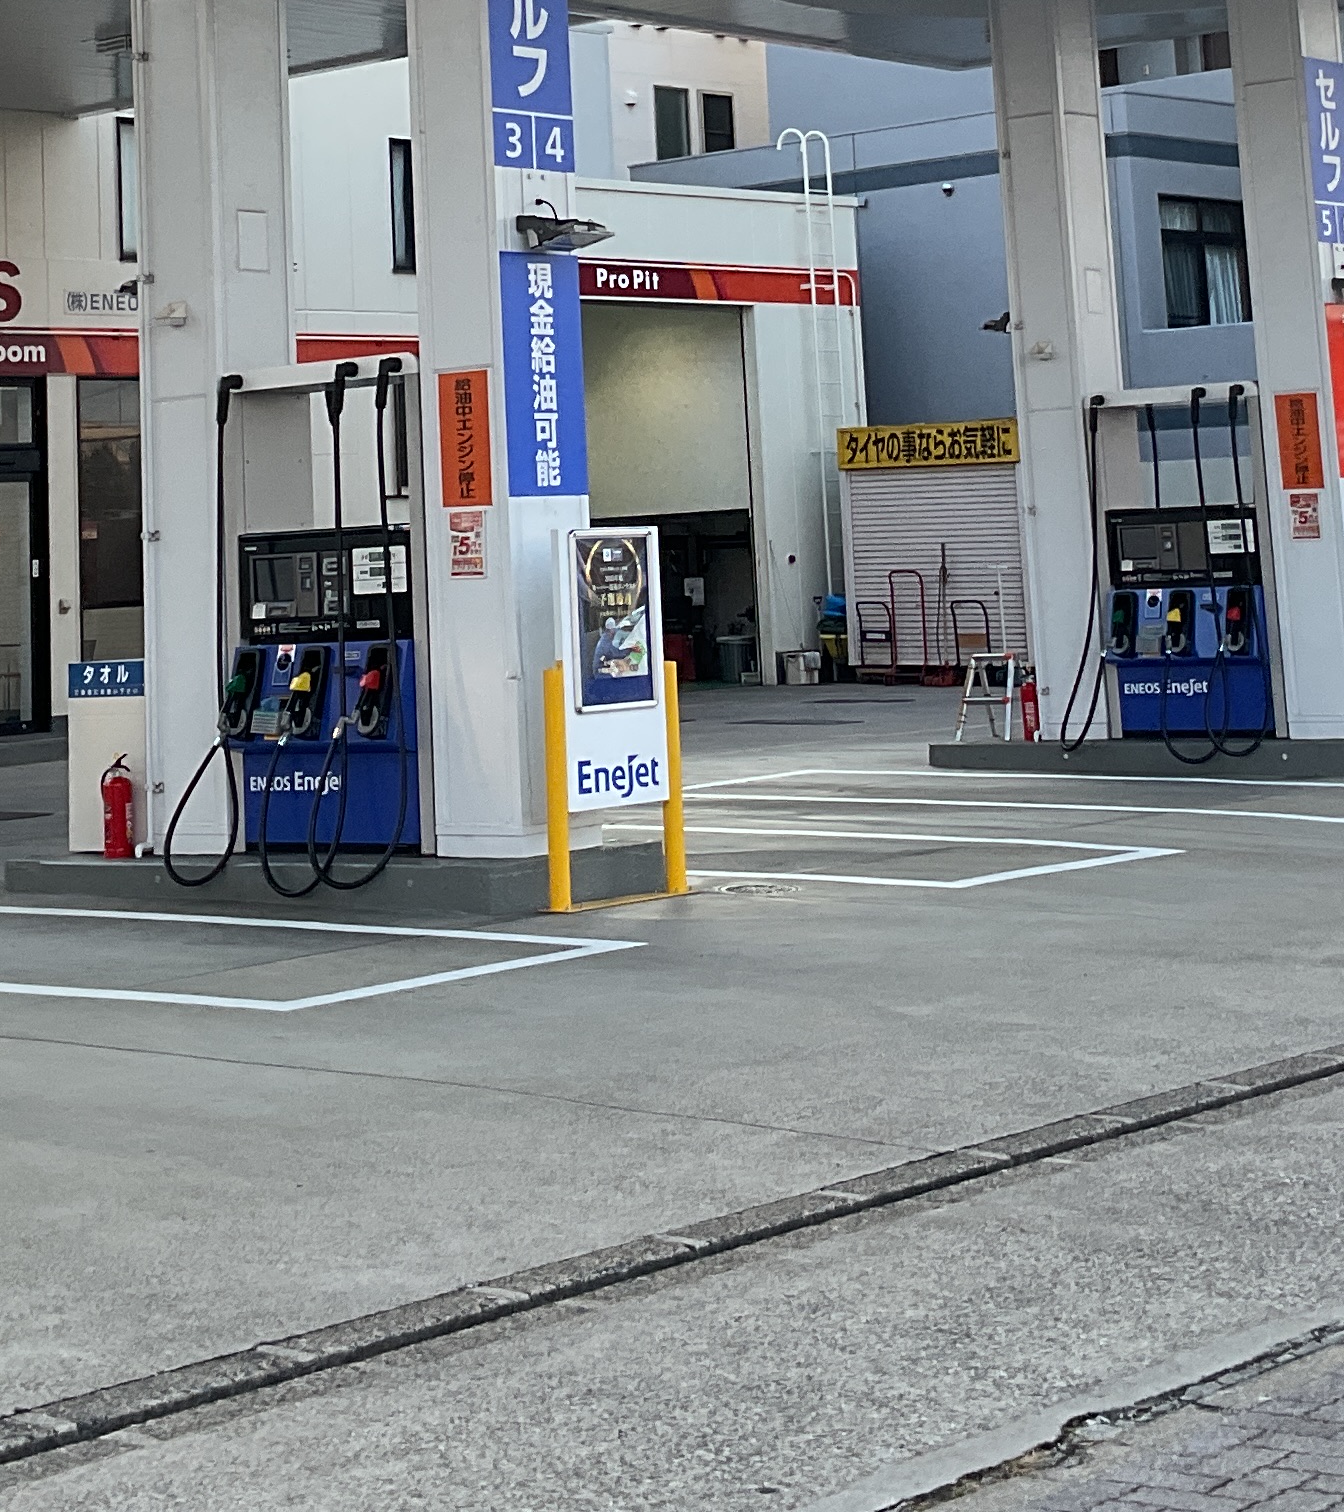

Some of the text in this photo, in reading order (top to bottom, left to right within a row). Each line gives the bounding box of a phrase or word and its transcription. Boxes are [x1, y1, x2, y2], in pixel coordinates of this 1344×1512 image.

[506, 122, 565, 163] 3 4
[1315, 69, 1342, 192] セルフ
[1321, 210, 1332, 236] 5
[596, 267, 659, 290] Pro Pit
[527, 262, 561, 487] 現金給油可能
[454, 377, 476, 499] 給油中エンジン停止
[847, 424, 1012, 465] タイヤの事ならお気軽に
[83, 664, 129, 684] タオル
[1124, 682, 1160, 695] ENEOS
[250, 775, 291, 791] ENOS
[577, 754, 660, 798] Enejet
